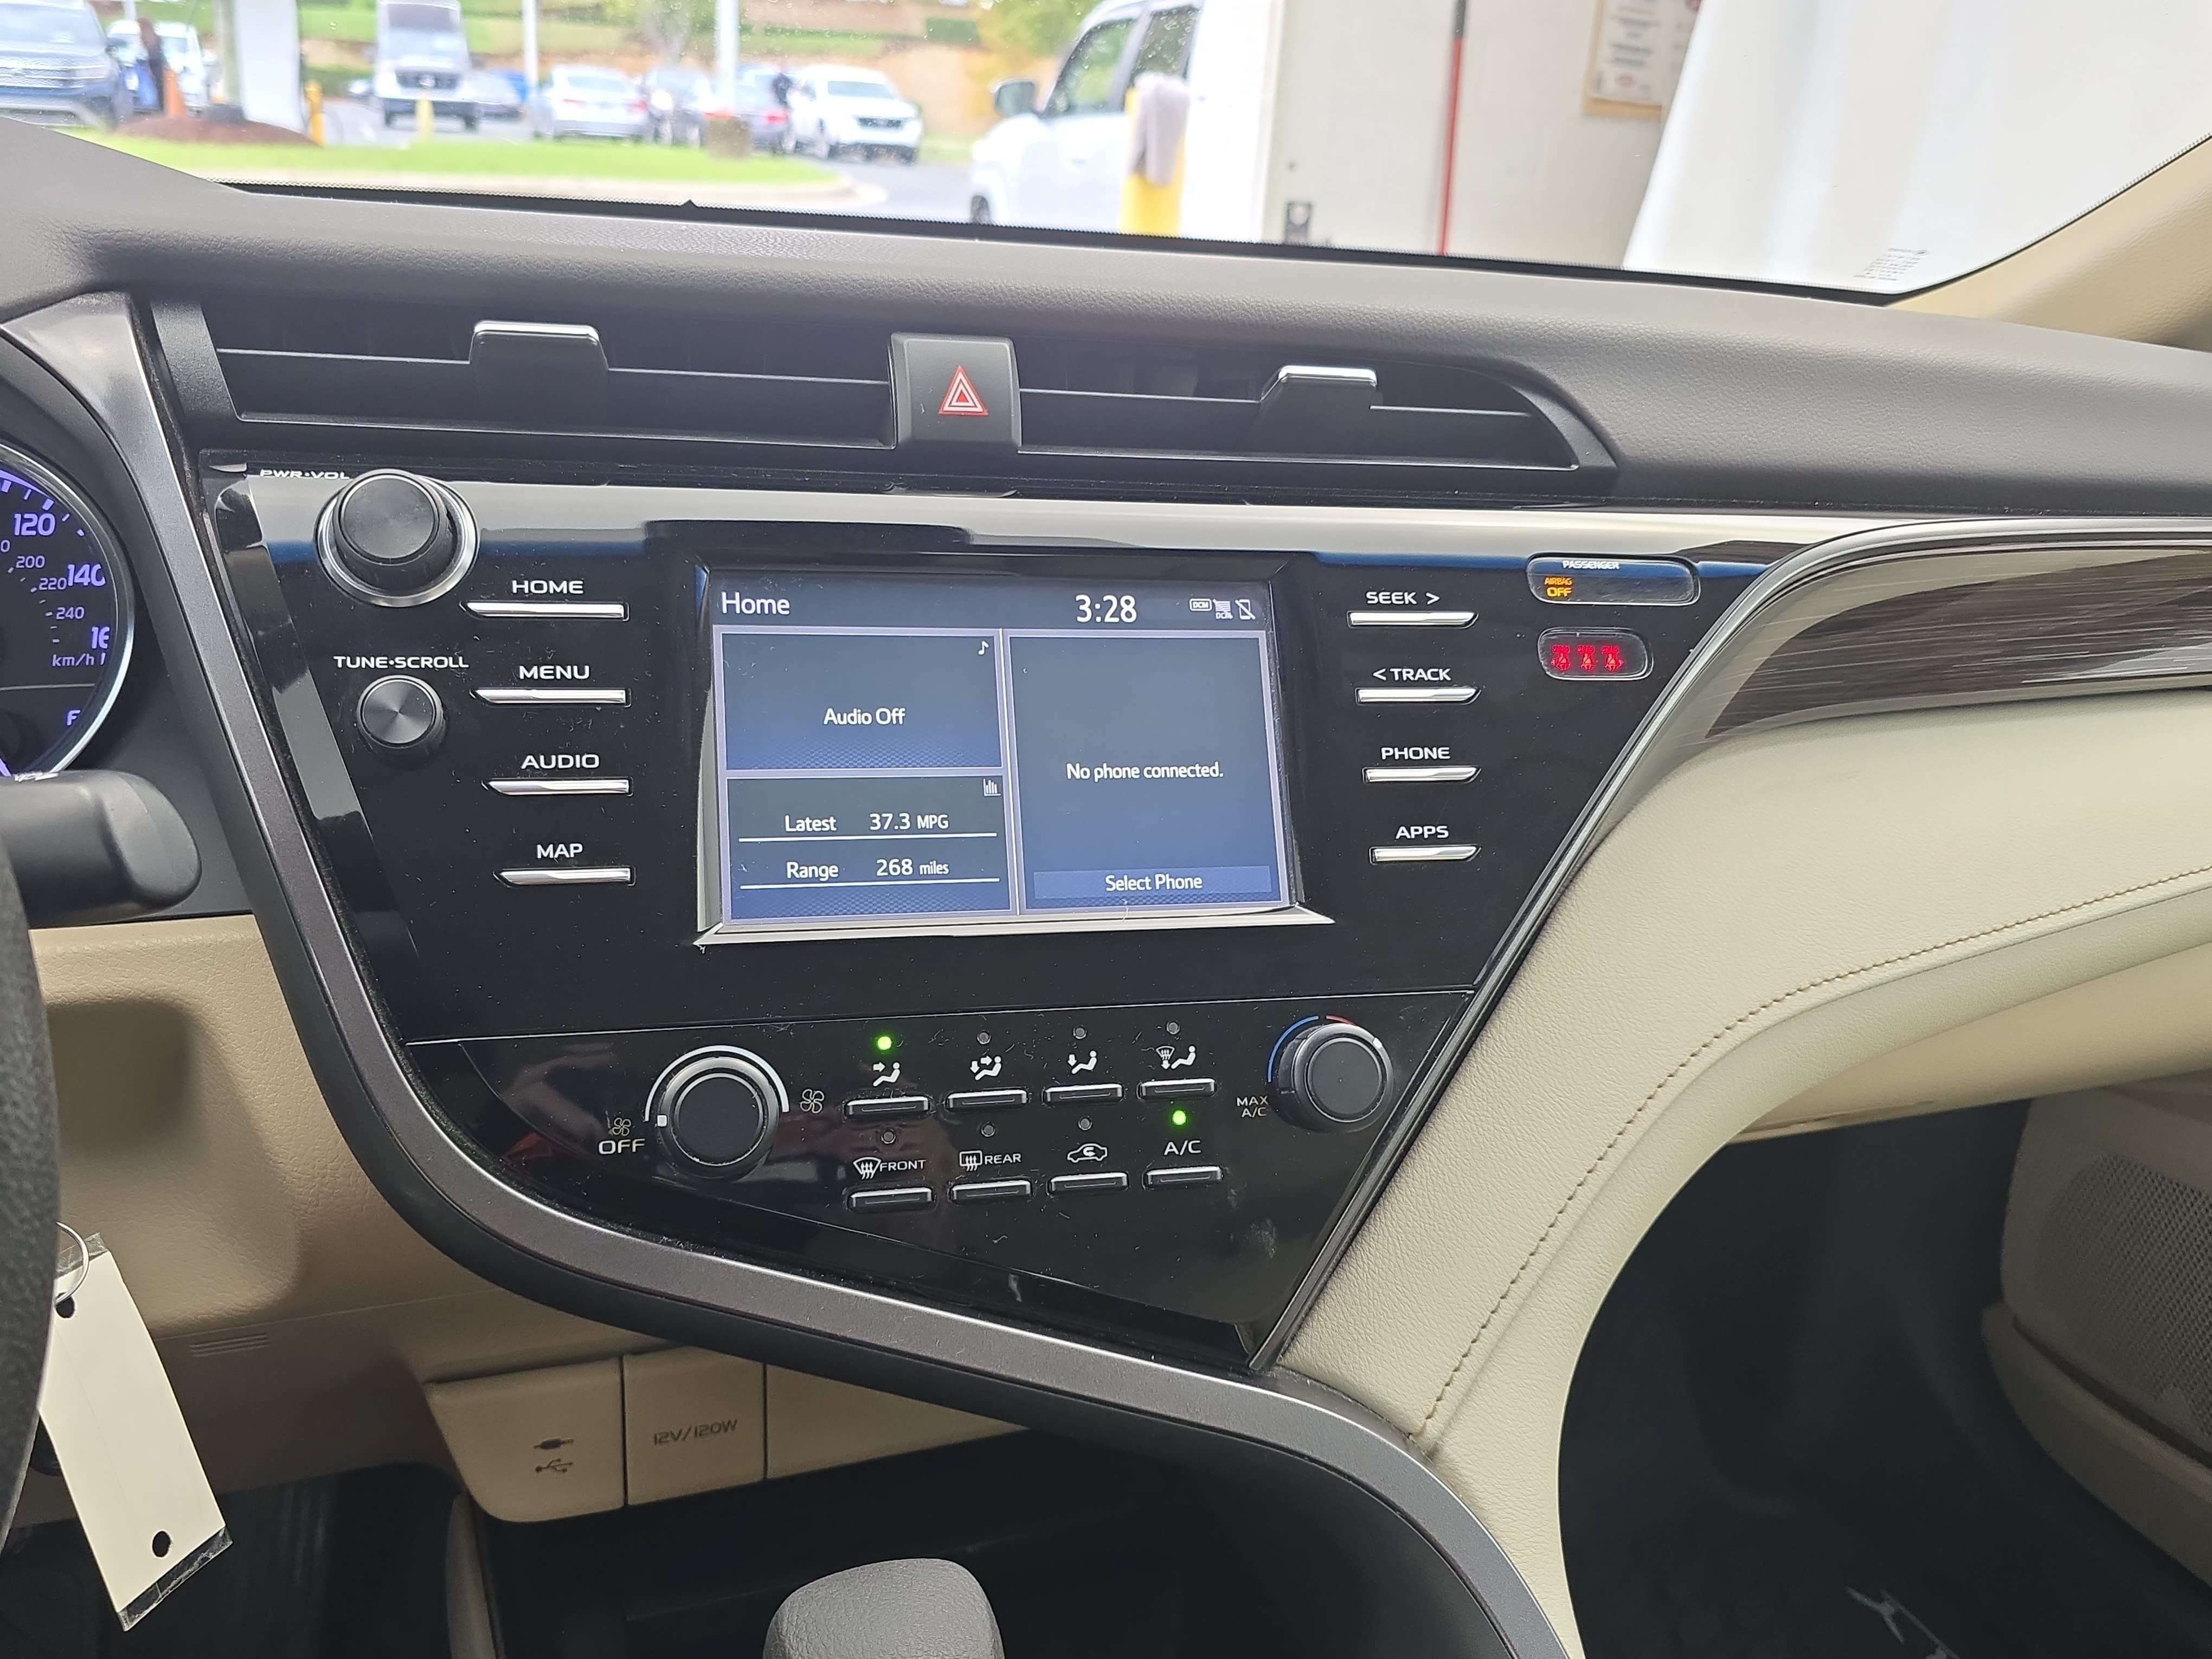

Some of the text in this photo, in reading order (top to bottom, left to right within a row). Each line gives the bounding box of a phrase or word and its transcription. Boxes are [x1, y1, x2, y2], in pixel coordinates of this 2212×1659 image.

[14, 513, 55, 536] 120
[16, 555, 45, 568] 200
[1562, 560, 1620, 569] PASSENGER
[68, 564, 106, 586] 140
[39, 577, 67, 590] 220
[512, 580, 583, 594] HOME
[1366, 591, 1417, 605] SEEK
[1547, 587, 1572, 597] OFF
[722, 591, 790, 615] Home
[1076, 594, 1137, 622] 3:28
[56, 606, 85, 620] 240
[92, 627, 110, 649] 16
[52, 653, 95, 666] km/h
[519, 665, 589, 679] MENU
[1390, 668, 1451, 681] TRACK
[67, 710, 81, 726] F
[824, 708, 905, 725] Audio Off
[1381, 747, 1451, 760] PHONE
[521, 754, 600, 769] AUDIO
[1066, 761, 1224, 782] No phone connected.
[785, 813, 949, 832] Latest 37.3 MPG
[1396, 826, 1449, 839] APPS
[537, 843, 583, 859] MAP
[787, 858, 949, 882] Range 268 miles
[1105, 873, 1203, 891] Select Phone
[1237, 1096, 1268, 1107] MAX
[1242, 1107, 1266, 1118] A/C
[599, 1139, 645, 1154] OFF
[1164, 1140, 1201, 1155] A/C
[878, 1159, 926, 1172] FRONT
[985, 1153, 1021, 1165] REAR
[654, 1418, 738, 1446] 12V/120W
